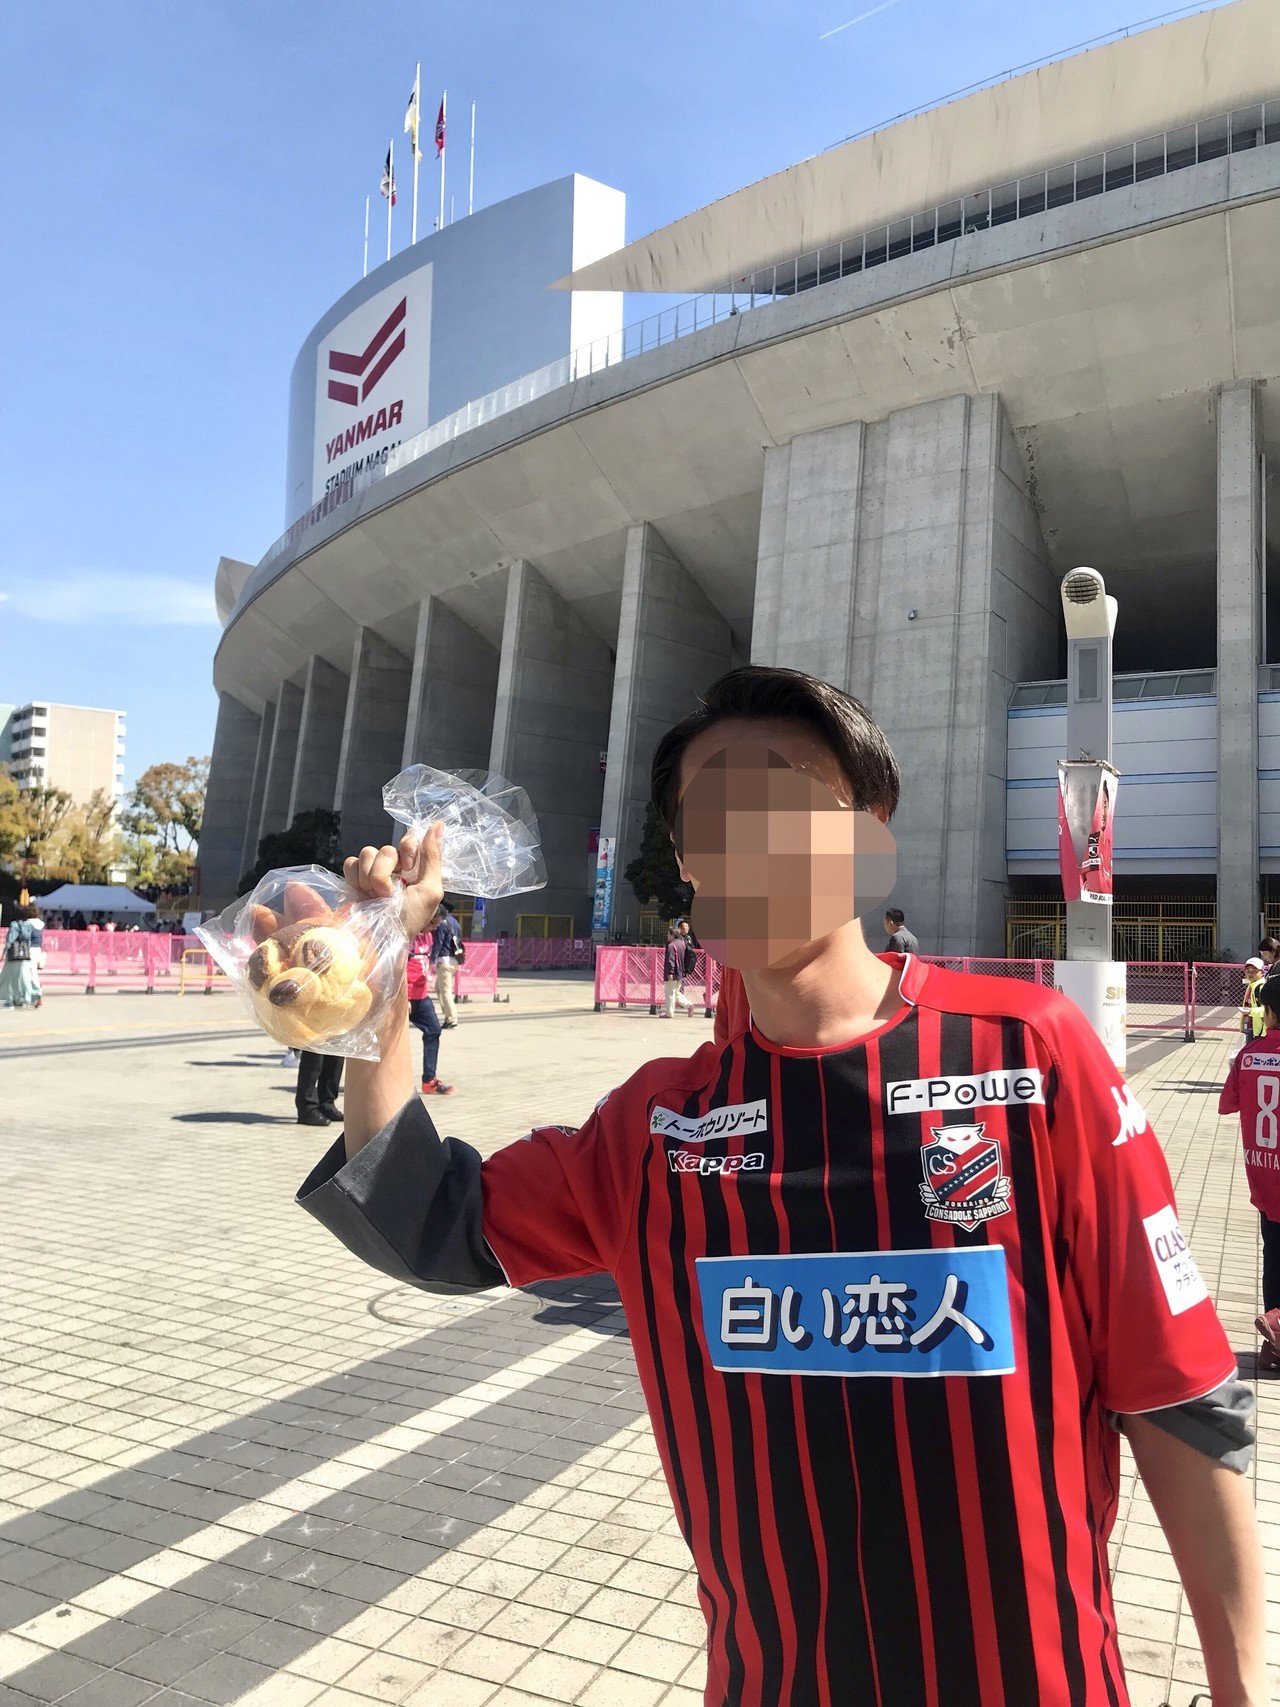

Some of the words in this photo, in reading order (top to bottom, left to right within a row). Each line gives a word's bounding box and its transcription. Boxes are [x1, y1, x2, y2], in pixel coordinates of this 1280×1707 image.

[325, 399, 404, 465] YANMAR
[325, 458, 364, 496] STADIUM
[1255, 1075, 1280, 1149] 8
[668, 1150, 765, 1175] Kappa
[1244, 1149, 1280, 1171] KAKITA
[929, 1206, 973, 1221] CONSADOLE
[973, 1201, 1008, 1221] SAPPORO
[944, 1197, 989, 1208] HOKKAIDO
[720, 1274, 990, 1349] 白い恋人
